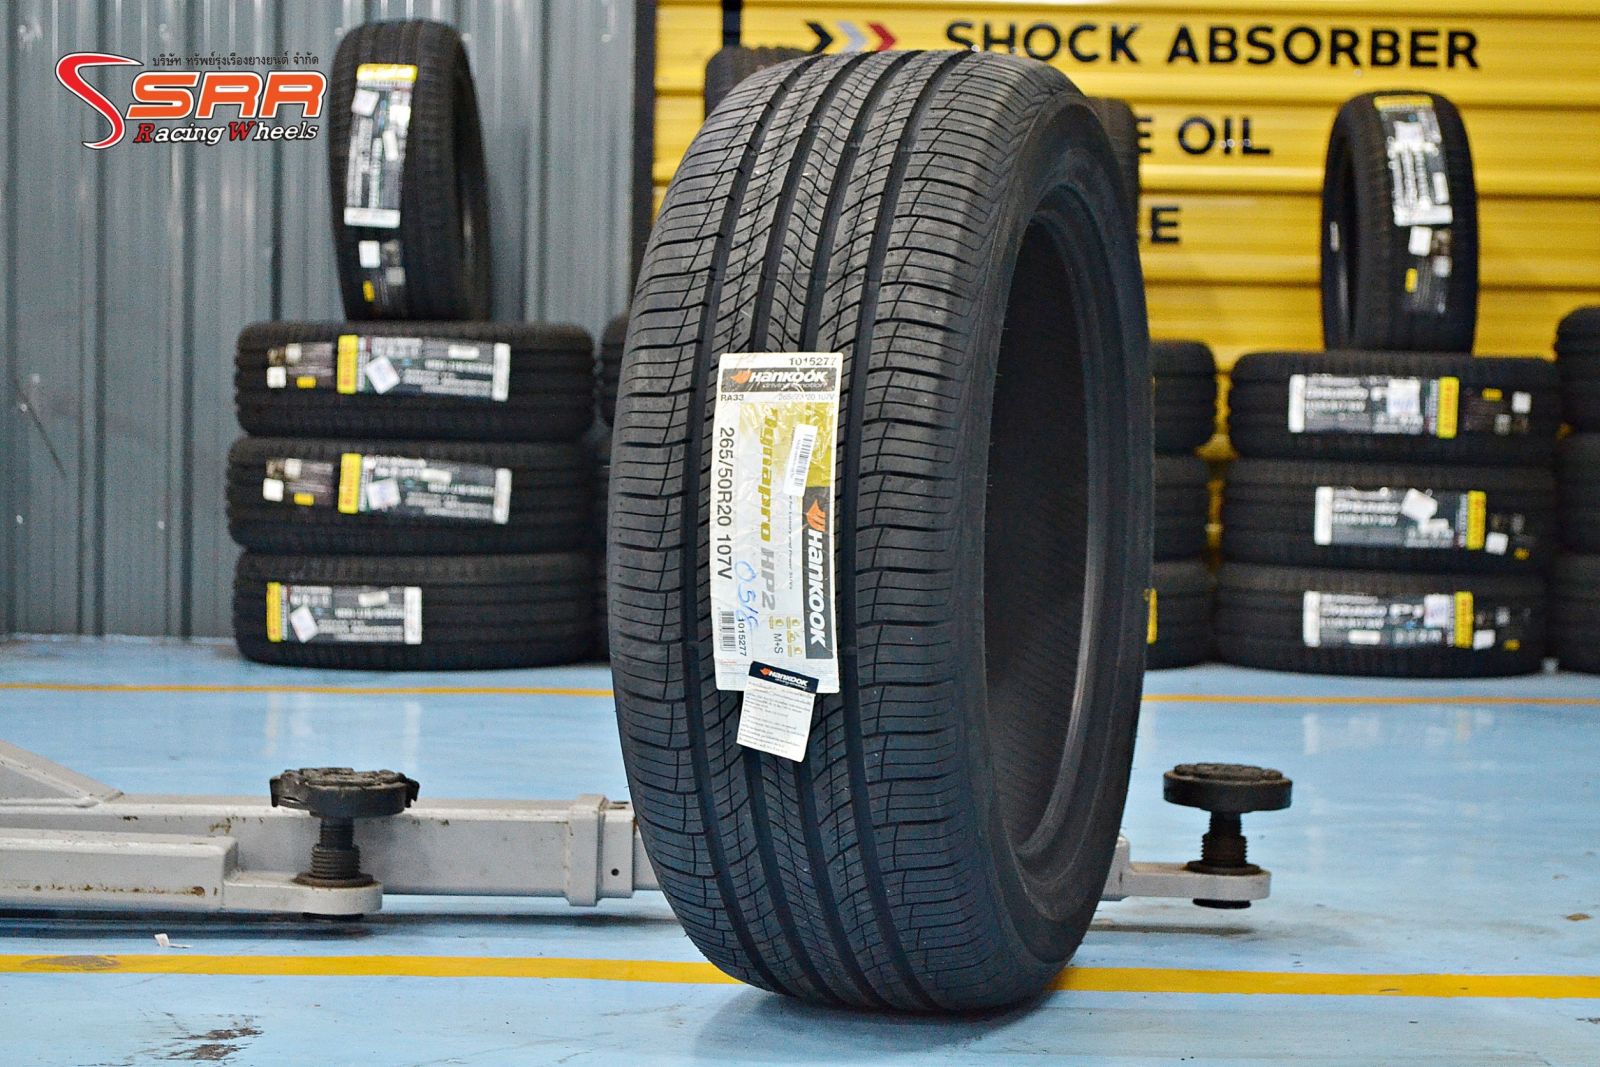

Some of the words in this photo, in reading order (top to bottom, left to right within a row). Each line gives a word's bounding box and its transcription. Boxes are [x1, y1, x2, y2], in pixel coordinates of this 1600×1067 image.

[946, 21, 1139, 63] SHOCK
[1167, 25, 1479, 69] ABSORBER
[1178, 116, 1271, 156] OIL
[789, 357, 837, 366] 1015277
[720, 394, 745, 402] RA33
[717, 427, 735, 527] 265/50R20
[716, 534, 733, 580] 107V
[760, 546, 776, 611] HP2
[737, 618, 747, 656] 1015277
[773, 633, 784, 654] M+S
